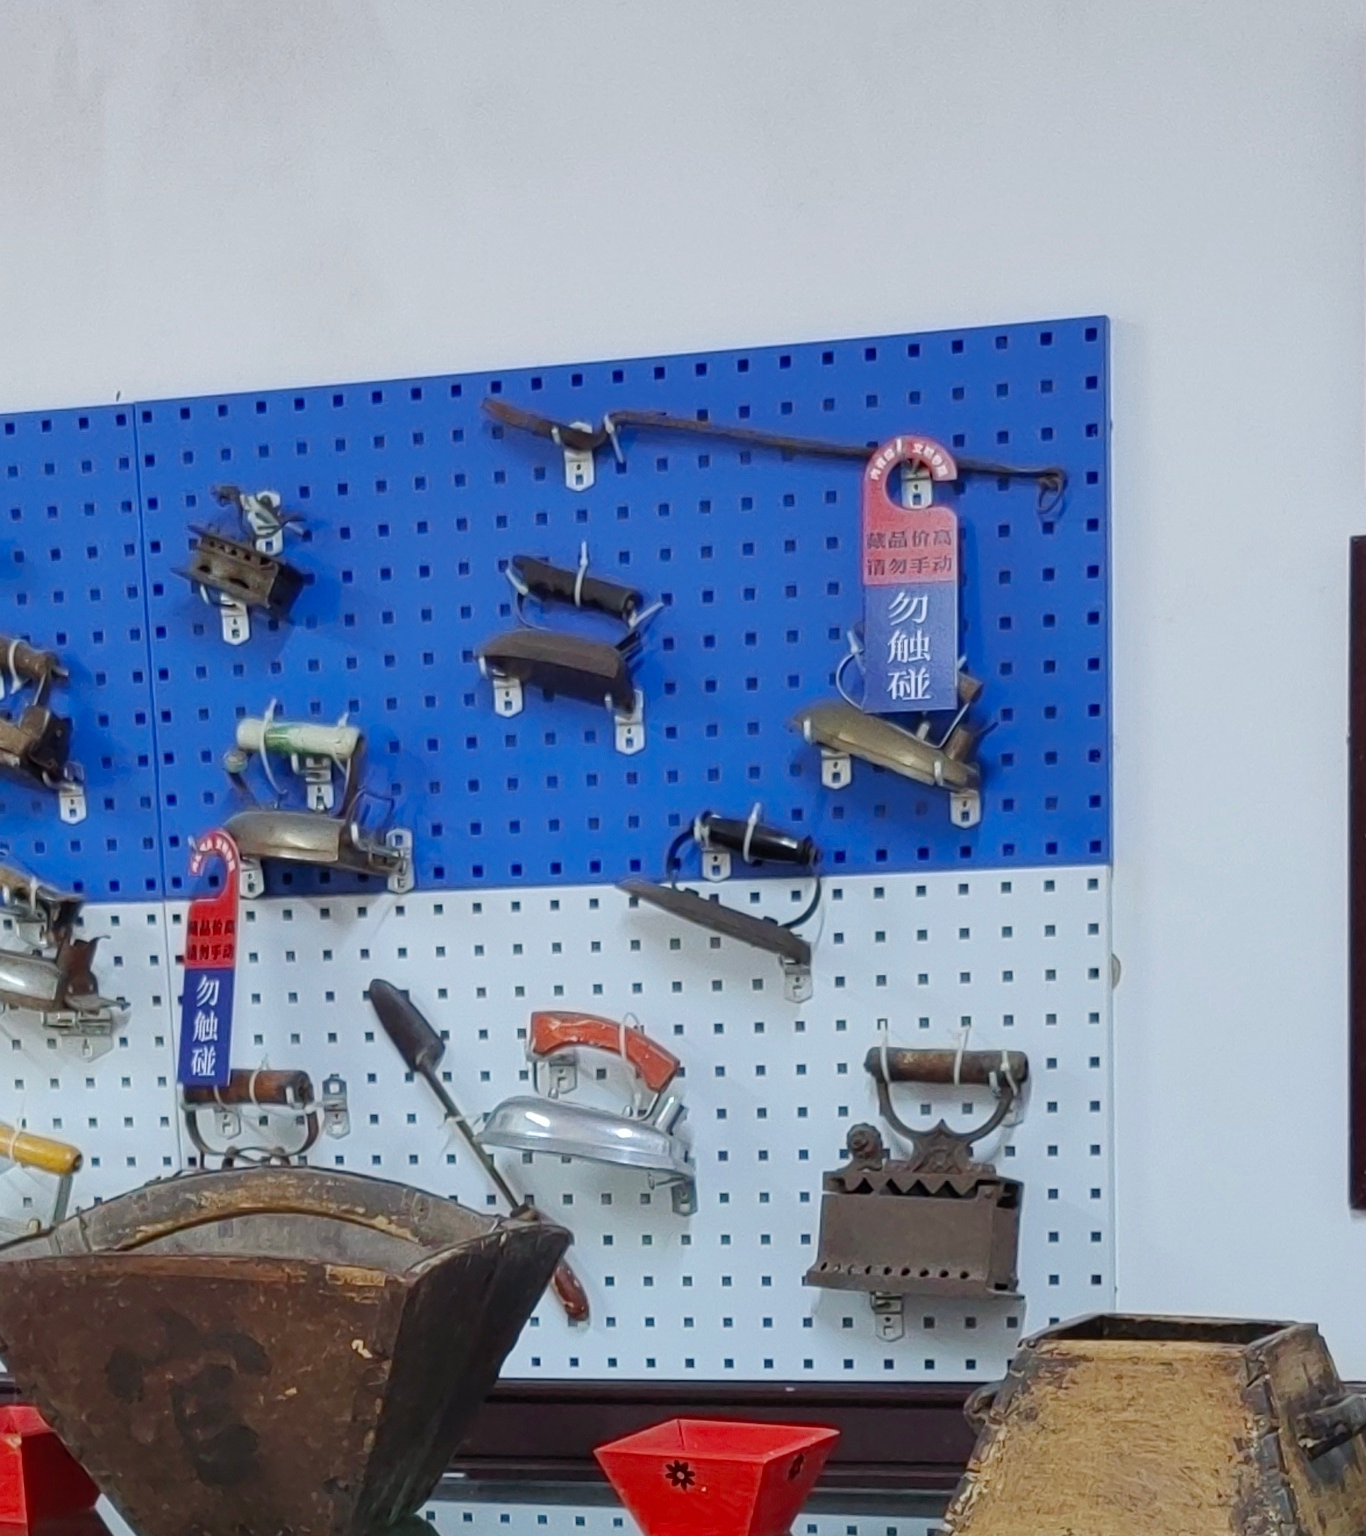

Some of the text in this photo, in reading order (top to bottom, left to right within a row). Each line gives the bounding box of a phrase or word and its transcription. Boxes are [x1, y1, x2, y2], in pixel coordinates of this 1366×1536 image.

[866, 529, 952, 549] 藏品价高
[866, 555, 952, 577] 请勿手动
[887, 592, 931, 701] 勿触碰
[191, 974, 221, 1077] 勿触碰
